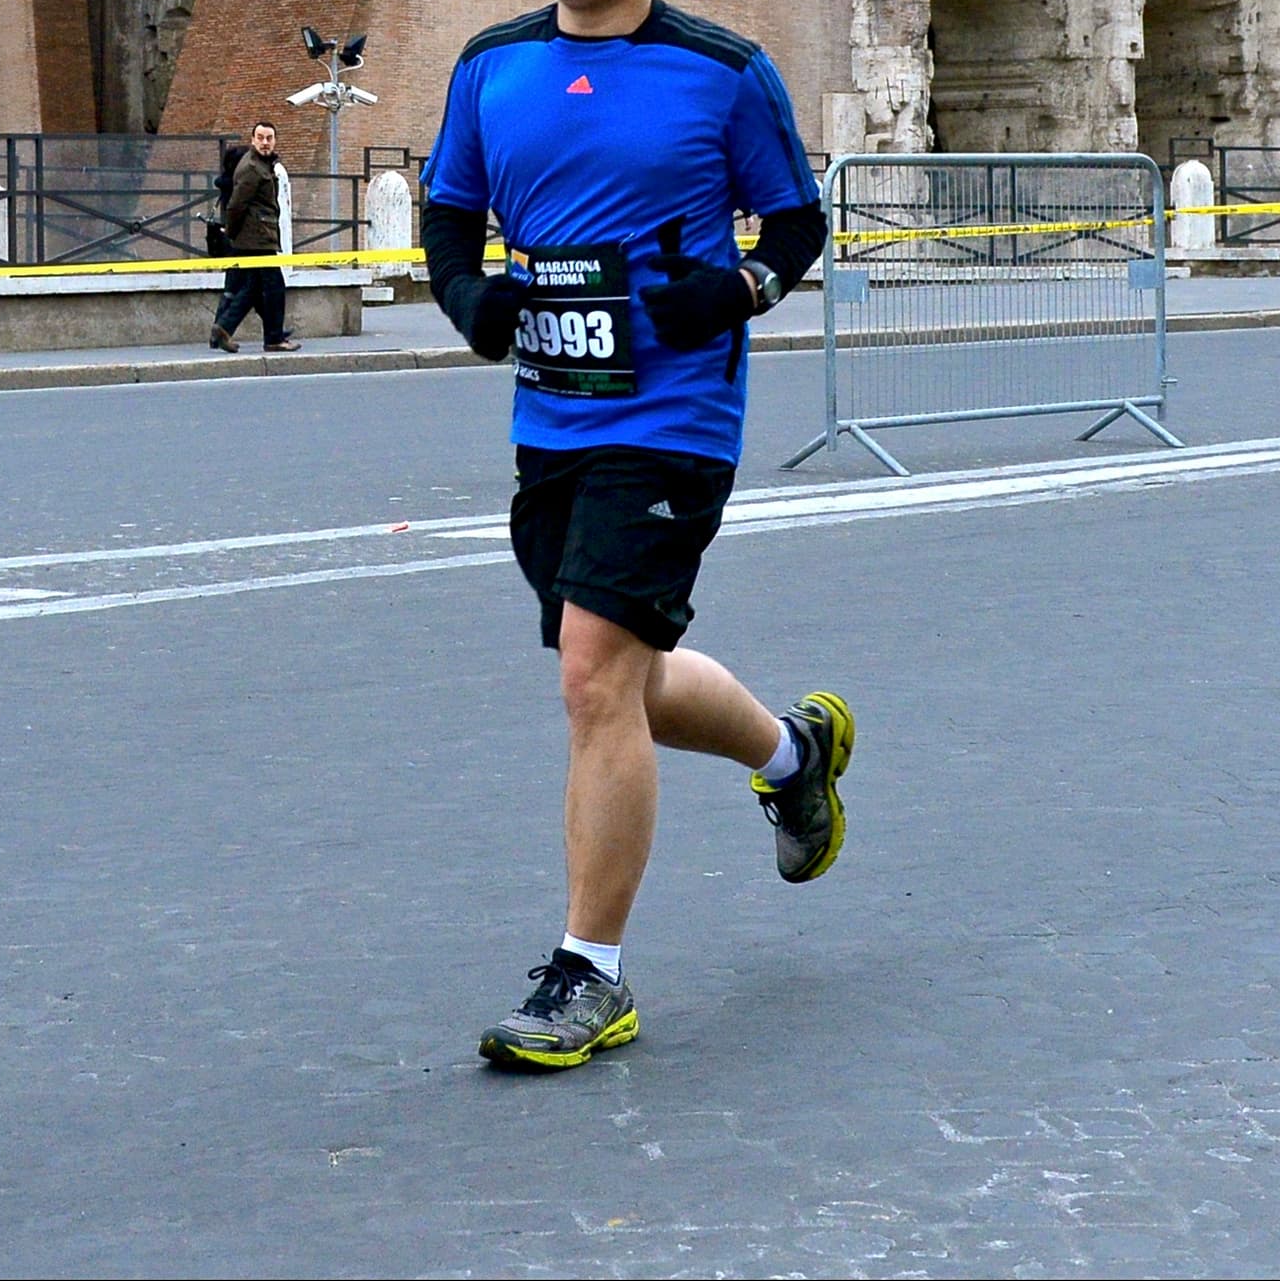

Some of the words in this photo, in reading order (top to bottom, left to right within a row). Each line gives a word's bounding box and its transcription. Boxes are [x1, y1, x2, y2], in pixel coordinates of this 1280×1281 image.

[535, 260, 601, 273] MARATONA
[537, 274, 548, 286] di
[549, 273, 585, 286] ROMA
